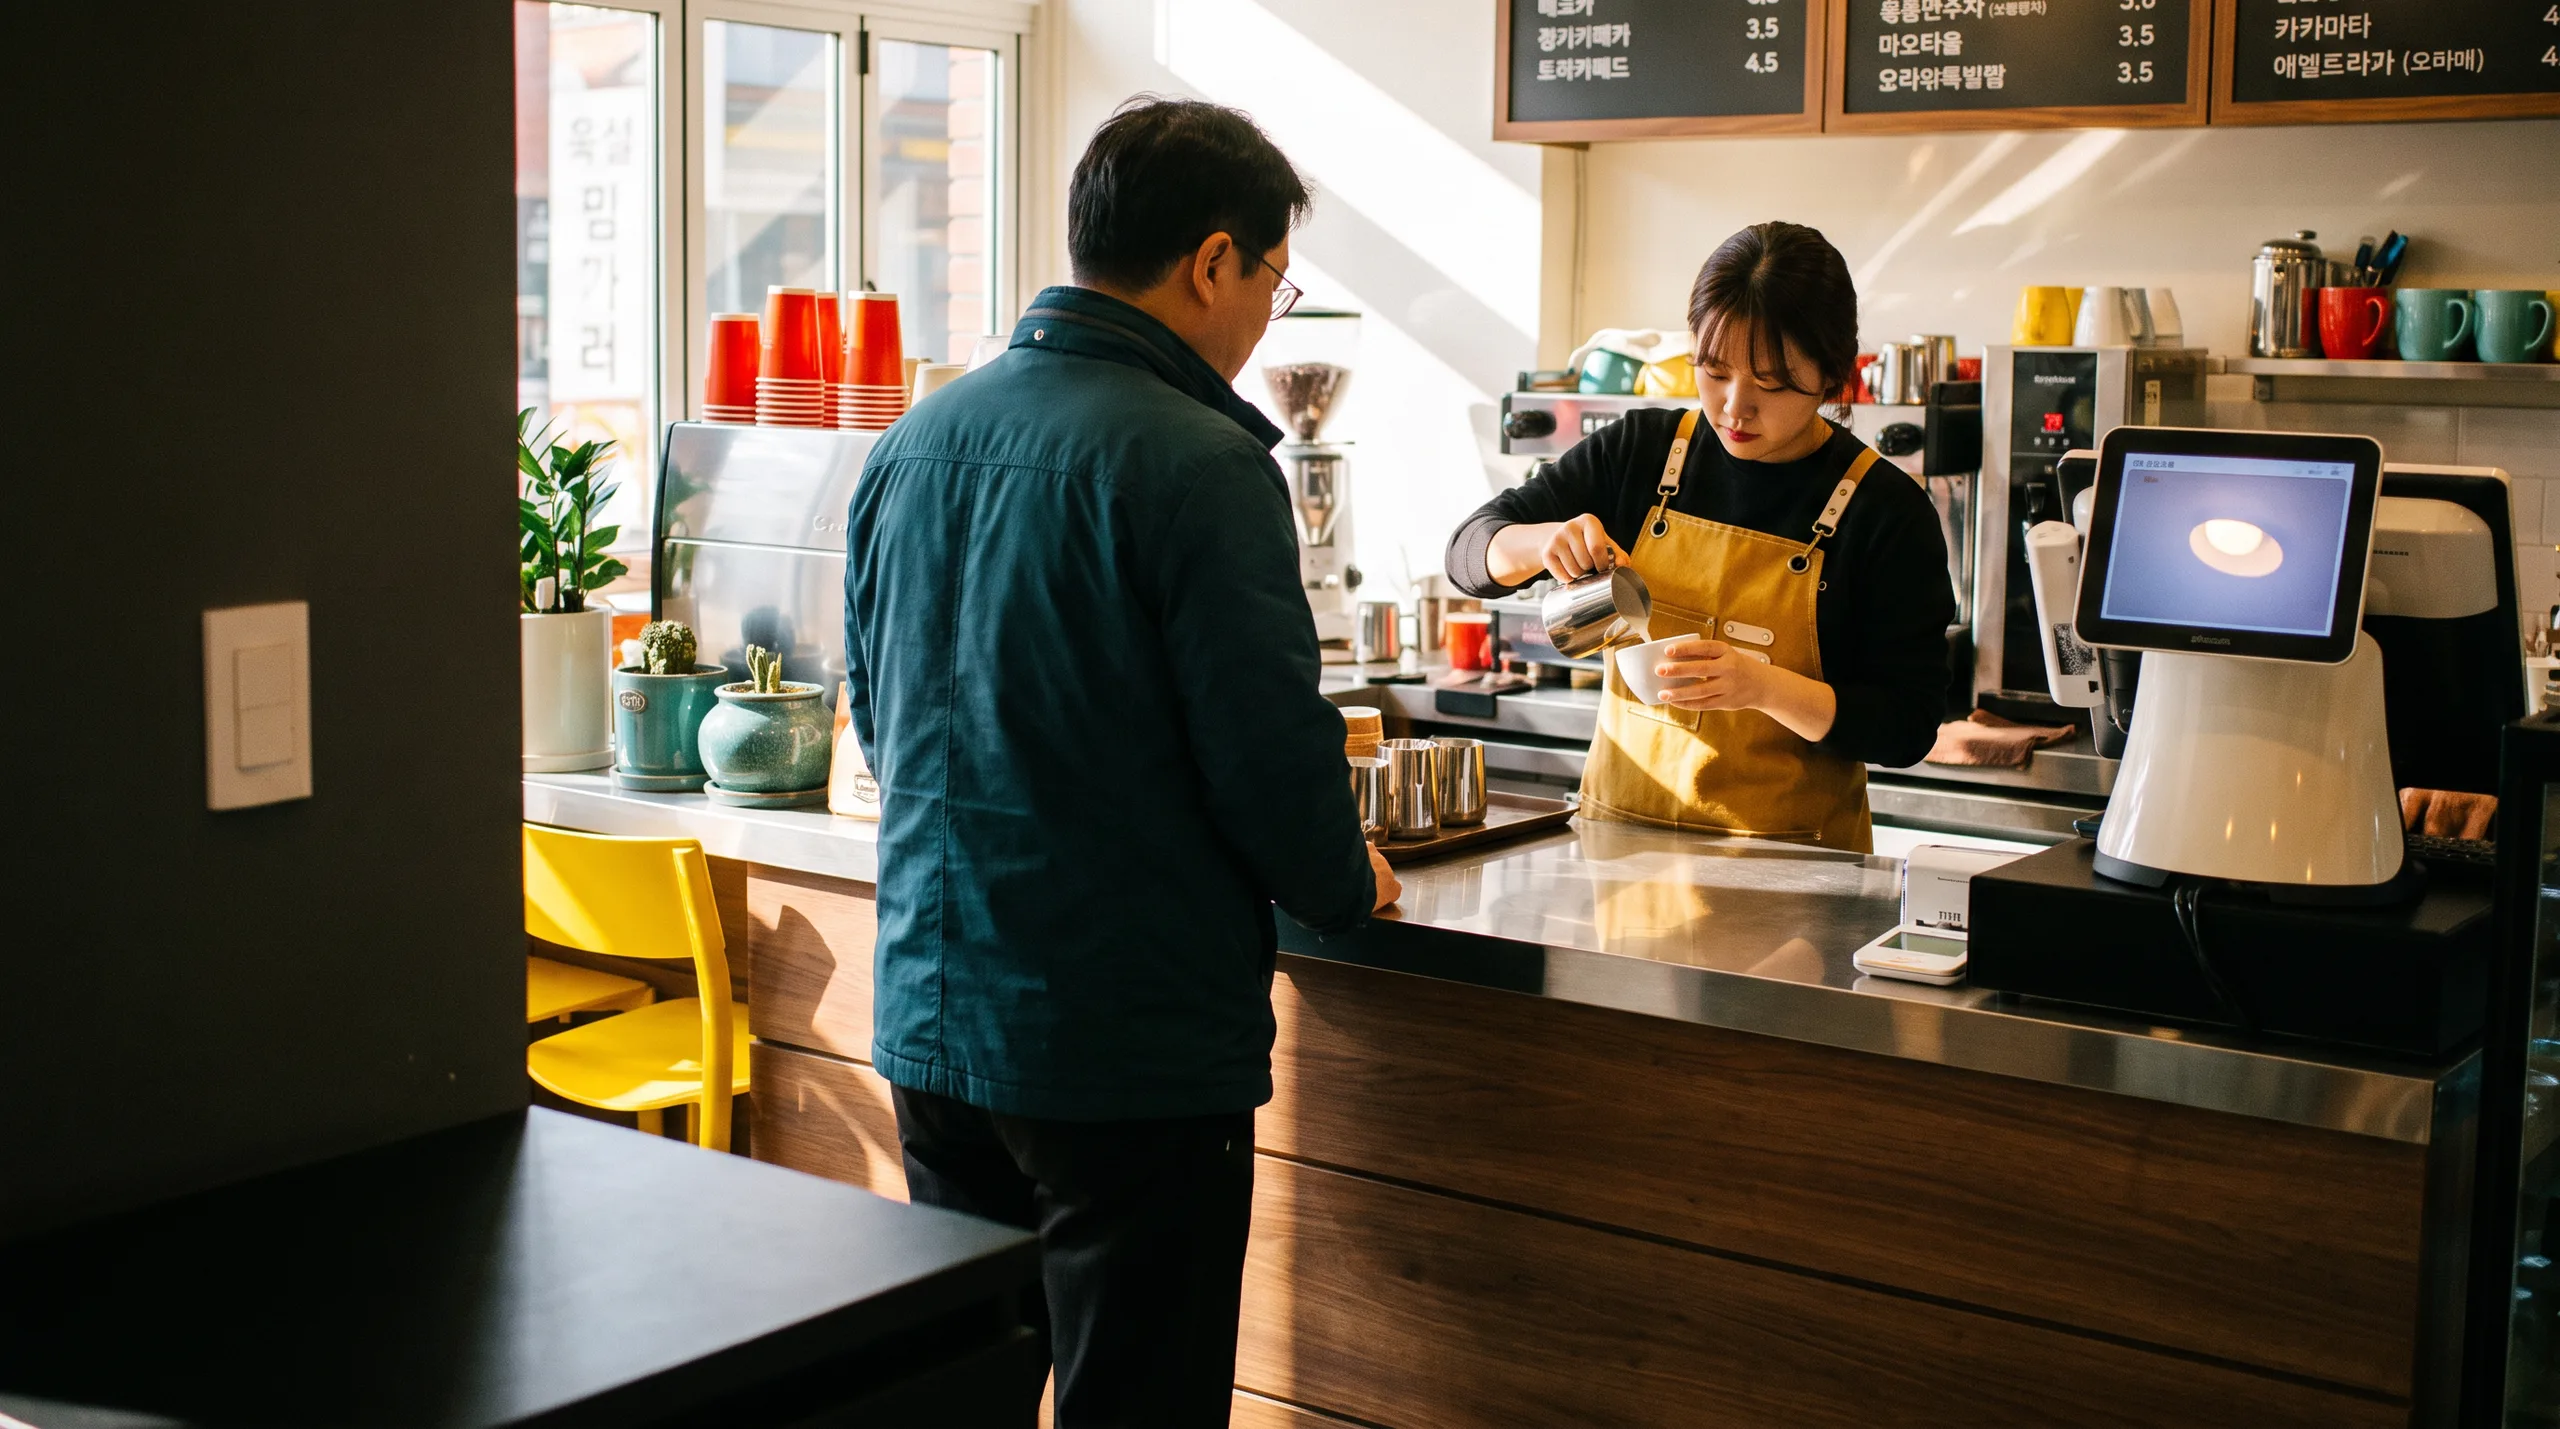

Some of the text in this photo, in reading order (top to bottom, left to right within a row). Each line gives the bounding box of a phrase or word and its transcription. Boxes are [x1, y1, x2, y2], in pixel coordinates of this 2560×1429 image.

[1746, 16, 1780, 40] 3.5
[2118, 24, 2155, 47] 3.5
[2275, 12, 2372, 42] 카카마타
[1744, 51, 1779, 74] 4.5
[2117, 61, 2154, 84] 3.5
